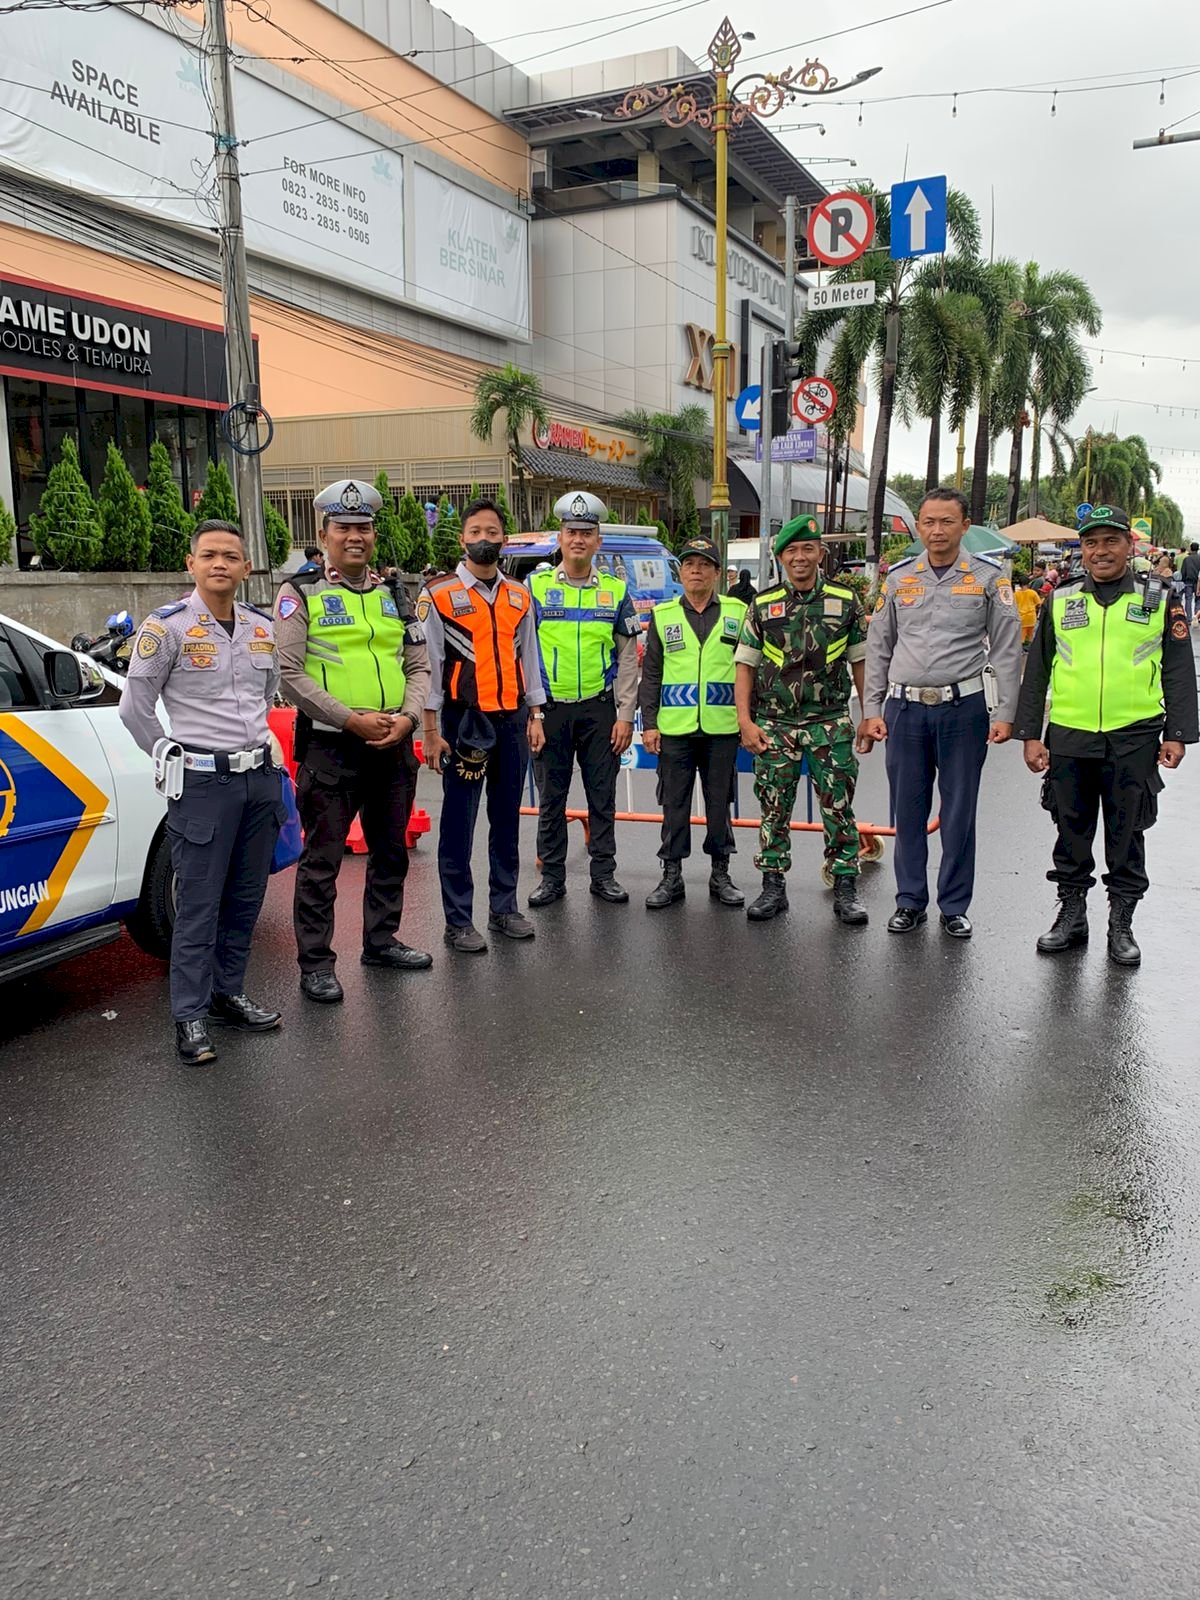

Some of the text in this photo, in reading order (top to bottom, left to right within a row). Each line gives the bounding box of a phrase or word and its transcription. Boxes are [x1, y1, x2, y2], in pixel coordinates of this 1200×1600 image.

[71, 59, 139, 107] SPACE
[50, 80, 161, 145] AVAILABLE
[282, 178, 306, 199] 0823
[316, 192, 339, 212] 2835
[347, 205, 369, 224] 0550
[283, 156, 366, 204] FOR MORE INFO
[283, 200, 308, 221] 0823
[317, 214, 340, 233] 2835
[348, 226, 370, 245] 0505
[440, 247, 506, 289] BERSINAR
[448, 228, 497, 265] KLATEN
[691, 225, 760, 293] KLTEN
[813, 287, 869, 306] 50 Meter
[0, 330, 152, 375] ODLES & TEMPURA
[71, 311, 151, 355] UDON
[1067, 598, 1084, 610] 24
[666, 625, 680, 636] 24
